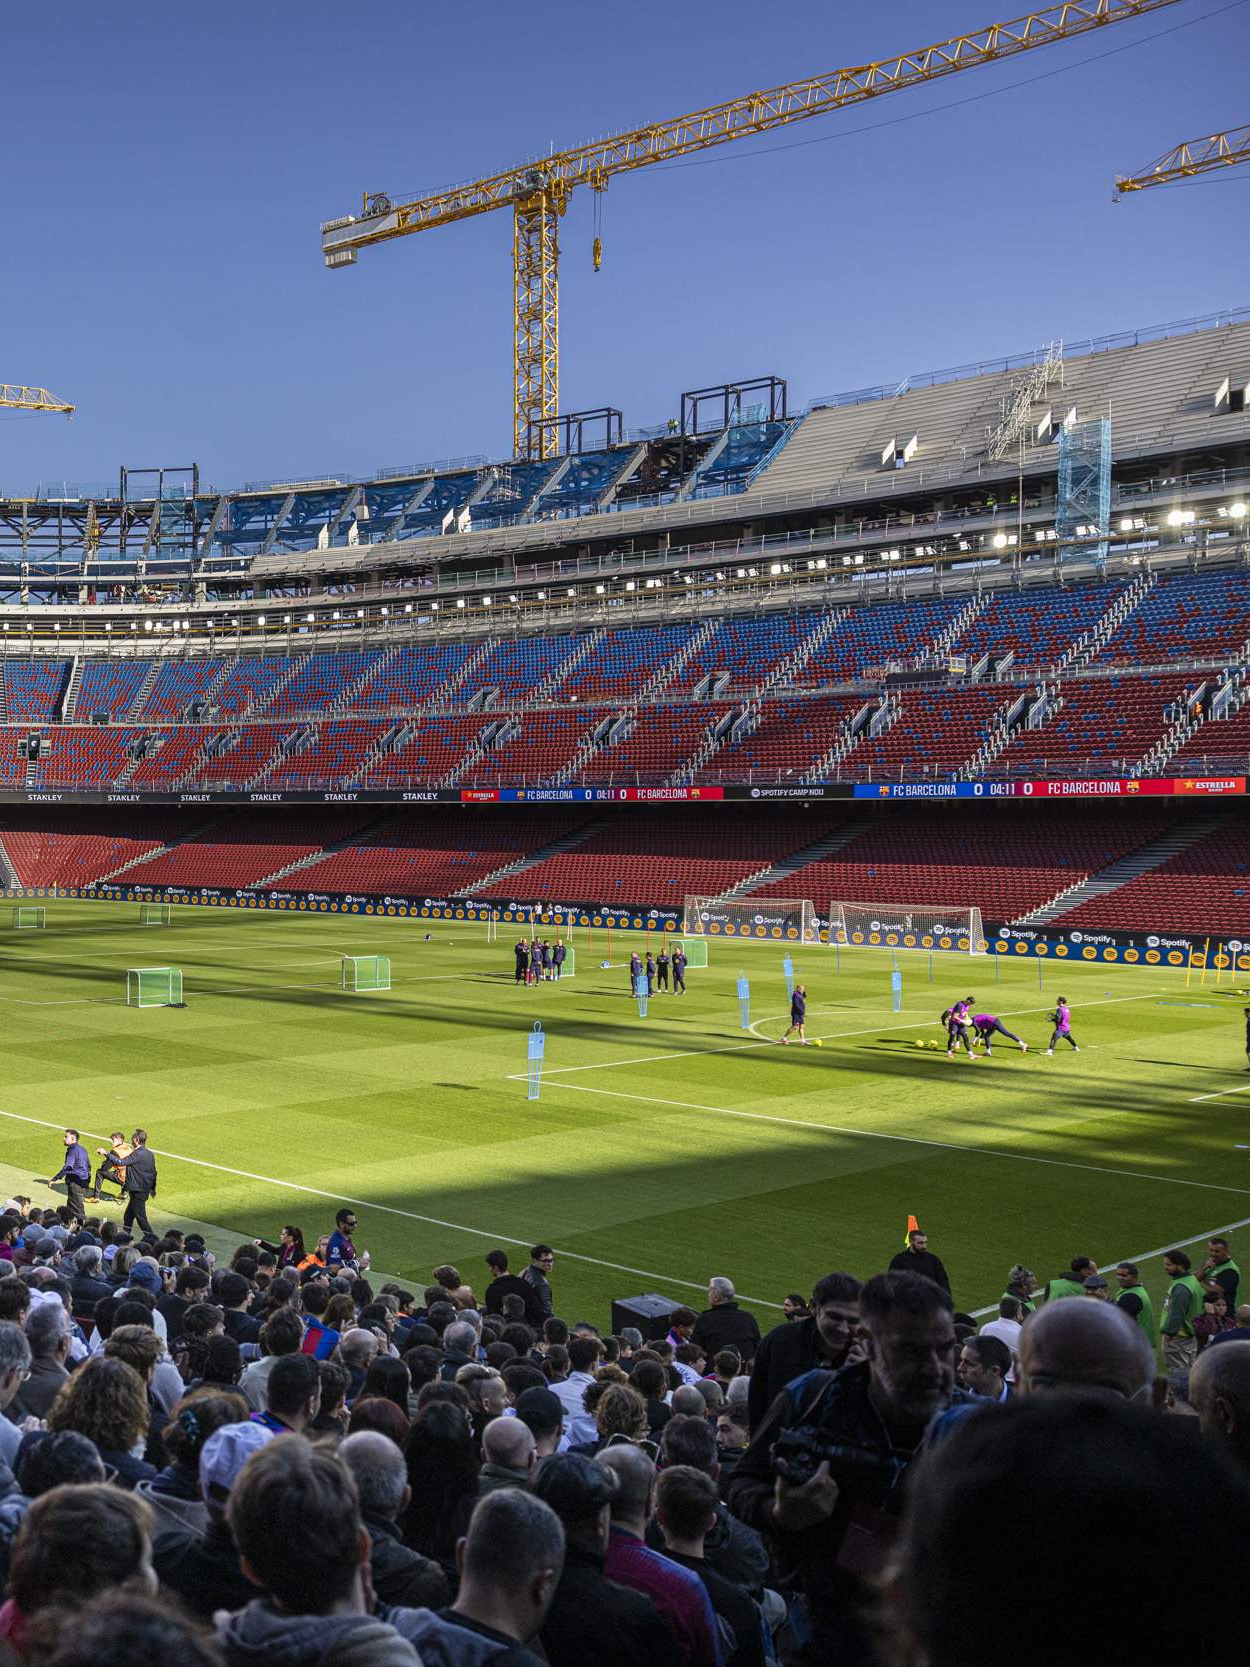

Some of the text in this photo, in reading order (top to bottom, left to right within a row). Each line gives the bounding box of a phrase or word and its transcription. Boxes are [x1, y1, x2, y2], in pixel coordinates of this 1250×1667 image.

[894, 782, 1121, 796] FC BARCELONA 0 04:11 0 FC BARCELONA
[527, 789, 688, 799] FC BARCELONA 0 04:11 0 FC BARCELONA
[610, 909, 626, 917] Spotify
[710, 914, 730, 922] Spotify
[944, 927, 969, 935] Spotify
[1011, 930, 1038, 939] Spotify
[1084, 934, 1111, 943] Spotify
[1160, 938, 1191, 947] Spotify
